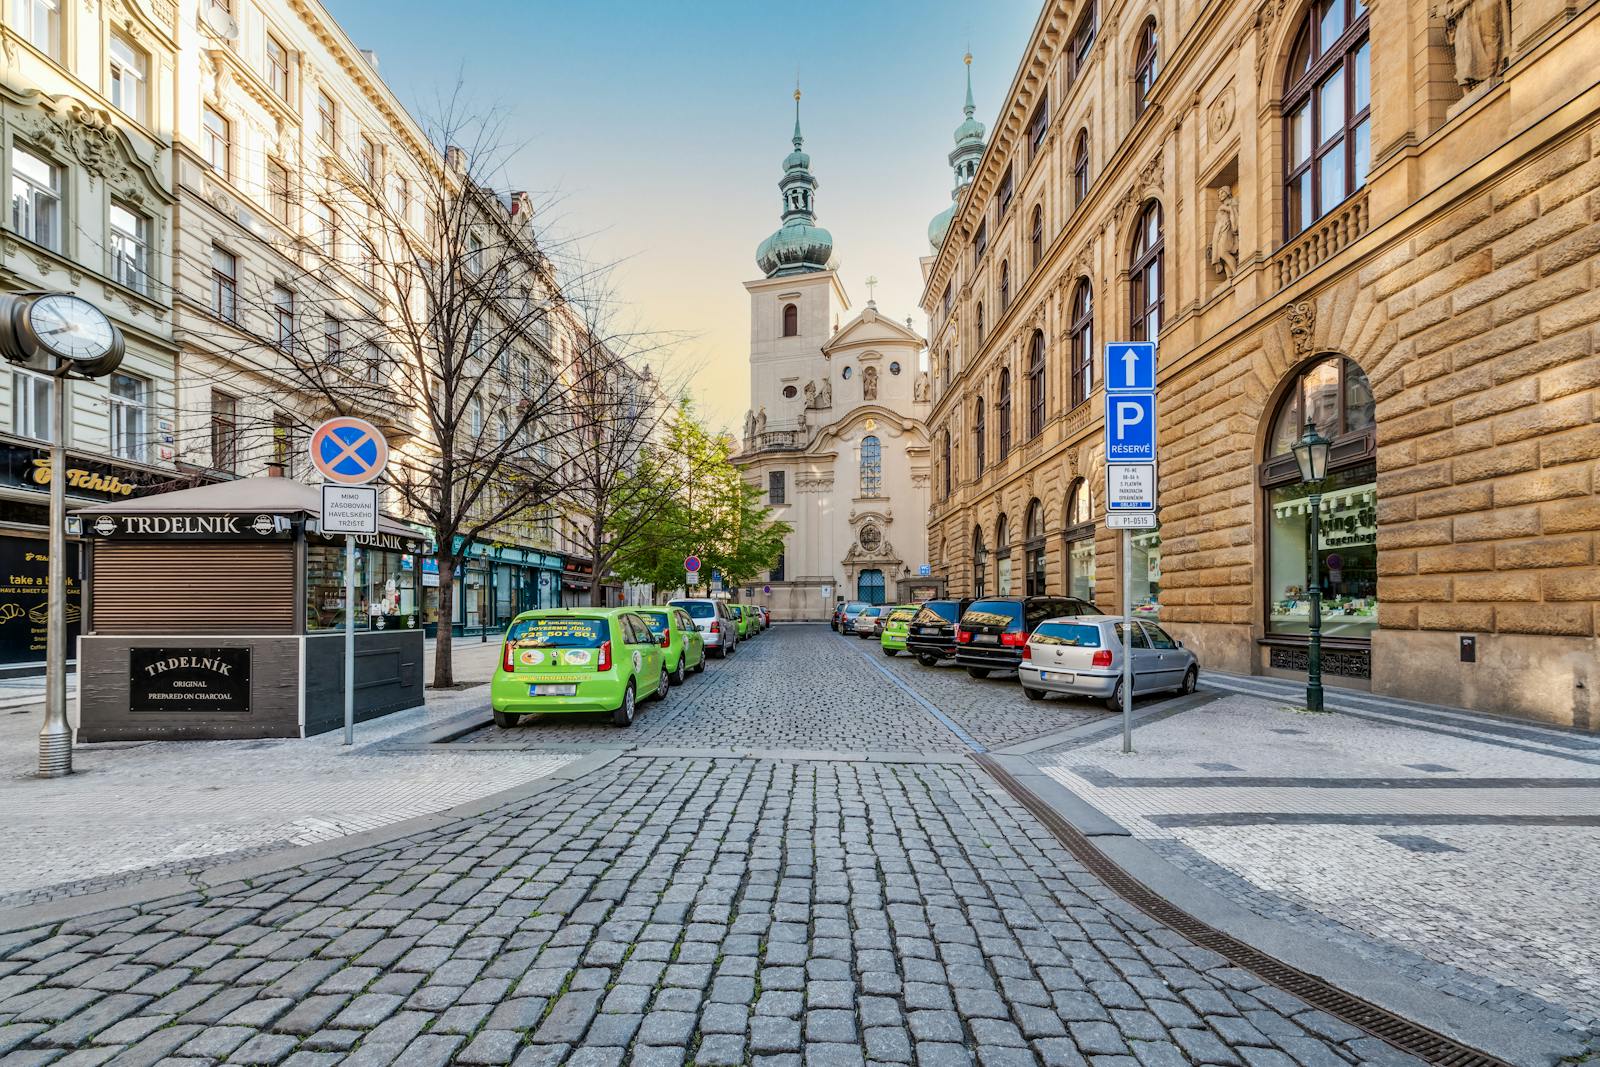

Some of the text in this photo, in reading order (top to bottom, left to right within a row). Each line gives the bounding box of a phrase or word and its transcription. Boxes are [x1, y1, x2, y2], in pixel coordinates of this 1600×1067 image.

[1117, 401, 1145, 440] P
[1112, 443, 1150, 453] RÉSERVÉ
[66, 468, 137, 496] Tchibo
[121, 514, 240, 534] TRDELNÍK
[9, 575, 33, 585] take
[36, 577, 42, 585] a
[144, 656, 232, 677] TRDELNÍK
